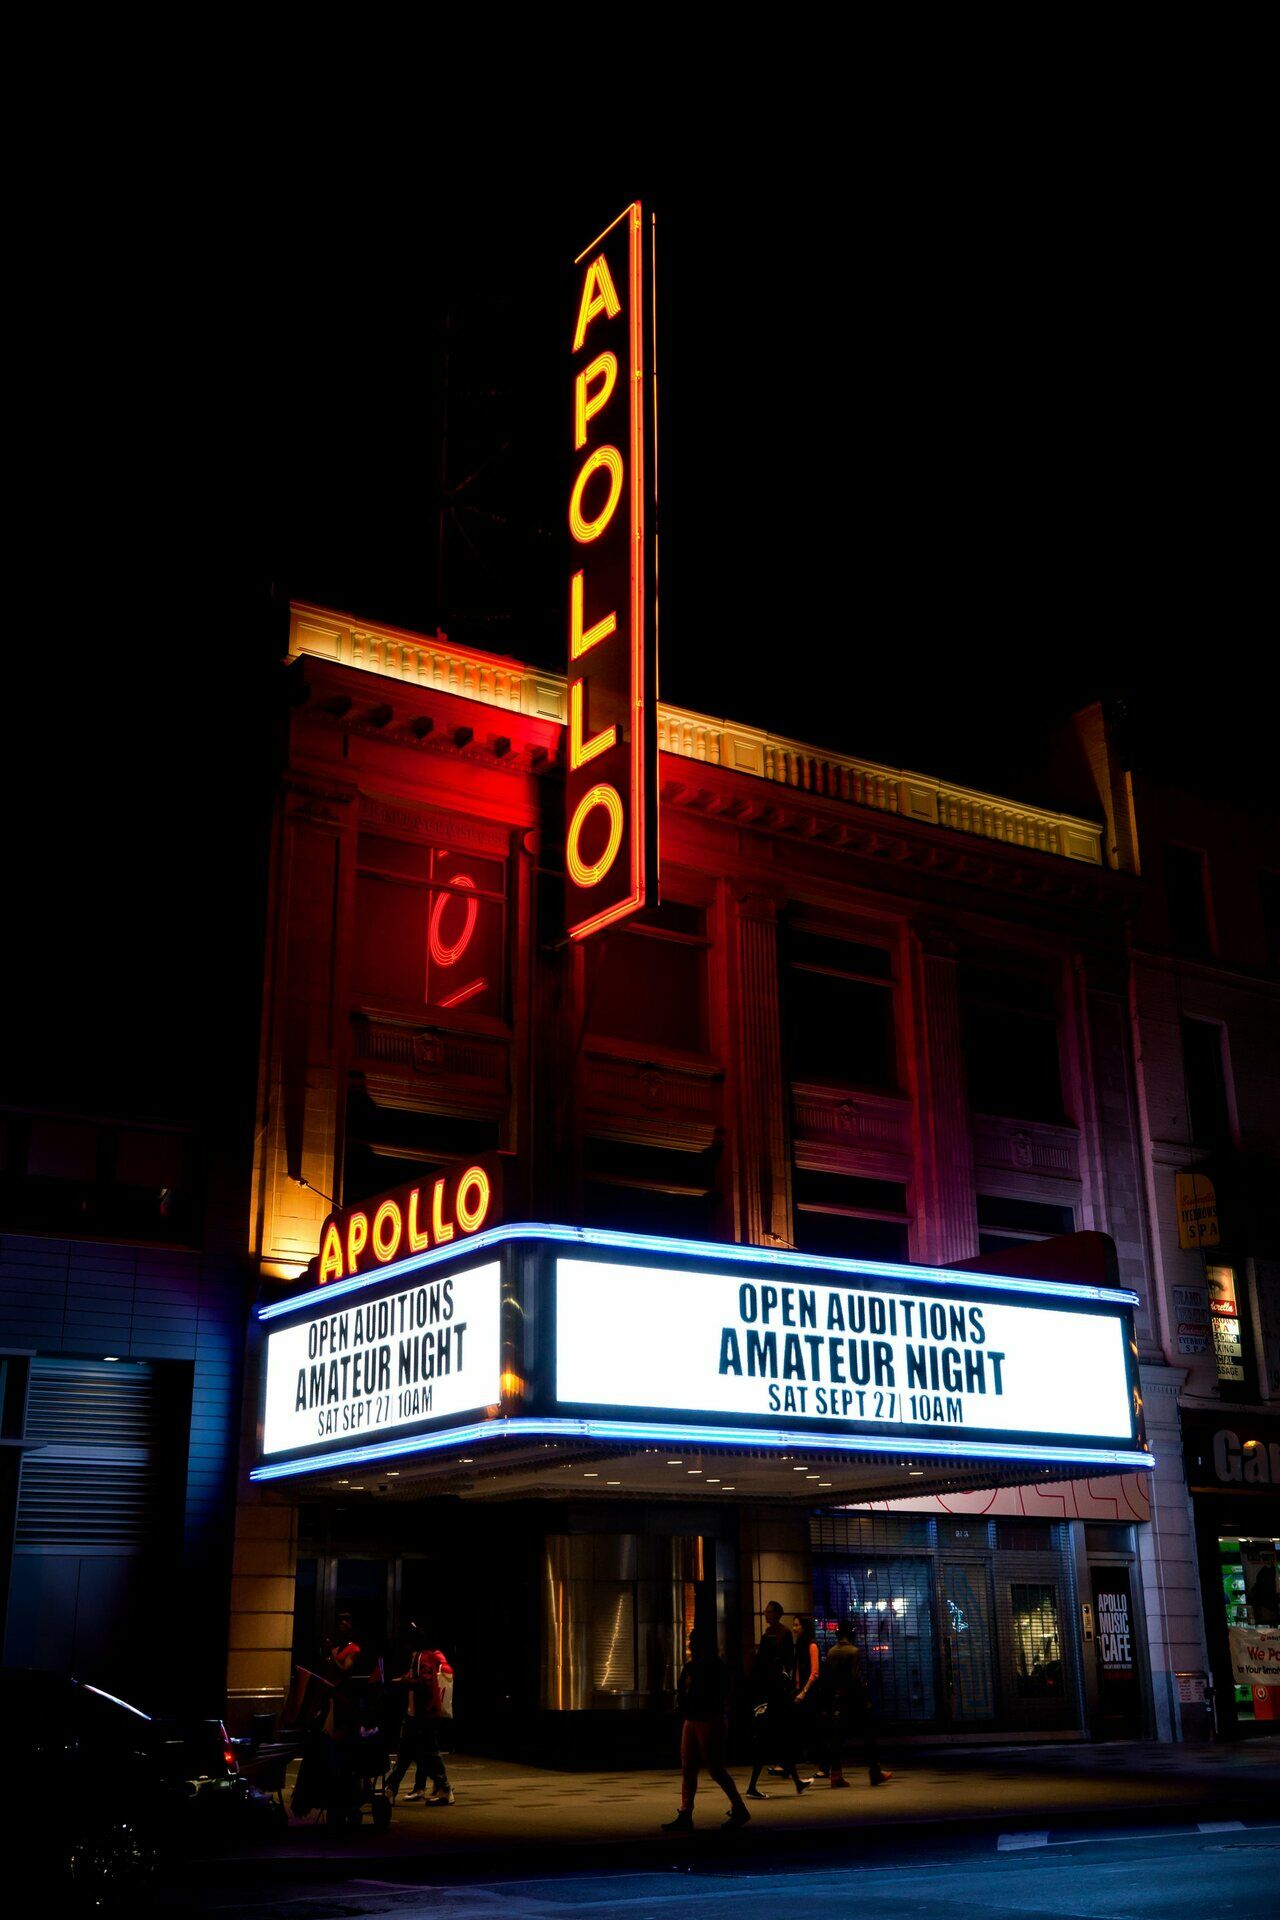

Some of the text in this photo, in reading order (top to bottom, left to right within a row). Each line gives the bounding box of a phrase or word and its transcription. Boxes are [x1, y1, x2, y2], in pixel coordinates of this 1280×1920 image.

[567, 253, 623, 888] APOLLO
[318, 1166, 490, 1285] APOLLO
[309, 1279, 454, 1360] OPEN AUDITIONS
[739, 1283, 986, 1344] OPEN AUDITIONS
[295, 1322, 467, 1412] AMATEUR NIGHT
[719, 1327, 1005, 1395] AMATEUR NIGHT
[318, 1385, 433, 1436] SAT SEPT 27 10AM
[768, 1384, 964, 1423] SAT SEPT 27 10AM
[1098, 1593, 1127, 1612] APOLLO
[1099, 1612, 1129, 1633] MUSIC
[1101, 1634, 1132, 1662] CAFE
[1247, 1646, 1265, 1661] We
